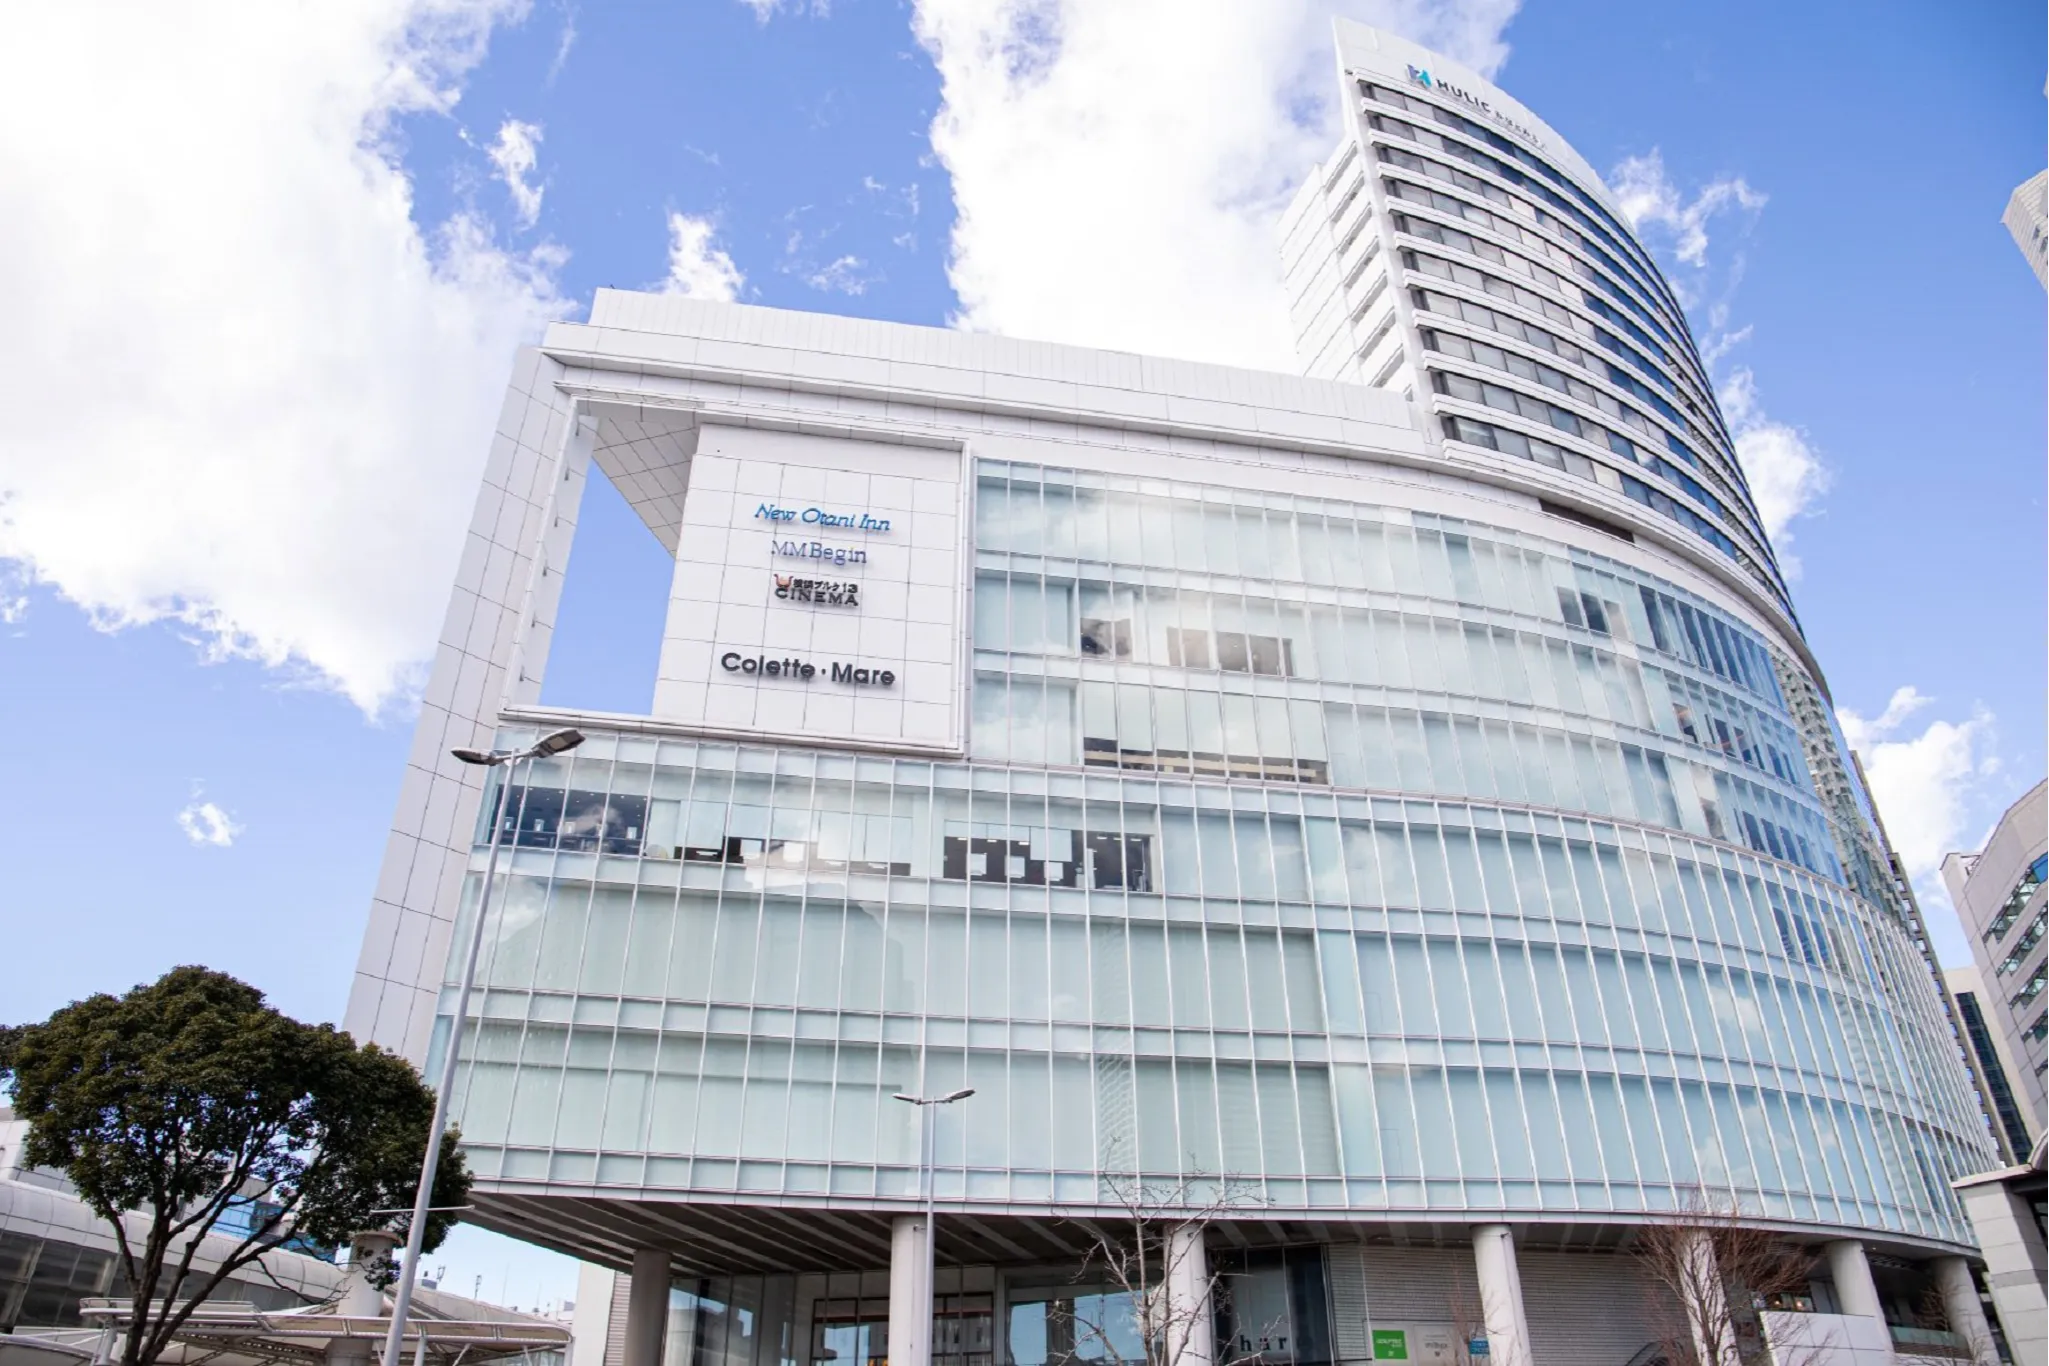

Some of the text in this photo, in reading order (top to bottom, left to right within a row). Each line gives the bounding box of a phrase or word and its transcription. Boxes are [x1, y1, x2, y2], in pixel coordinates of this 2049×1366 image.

[1436, 79, 1491, 112] HULIC
[755, 503, 892, 531] New Otani Inn
[775, 587, 859, 607] CINEMA
[721, 652, 816, 679] Colette
[831, 662, 896, 686] Mare
